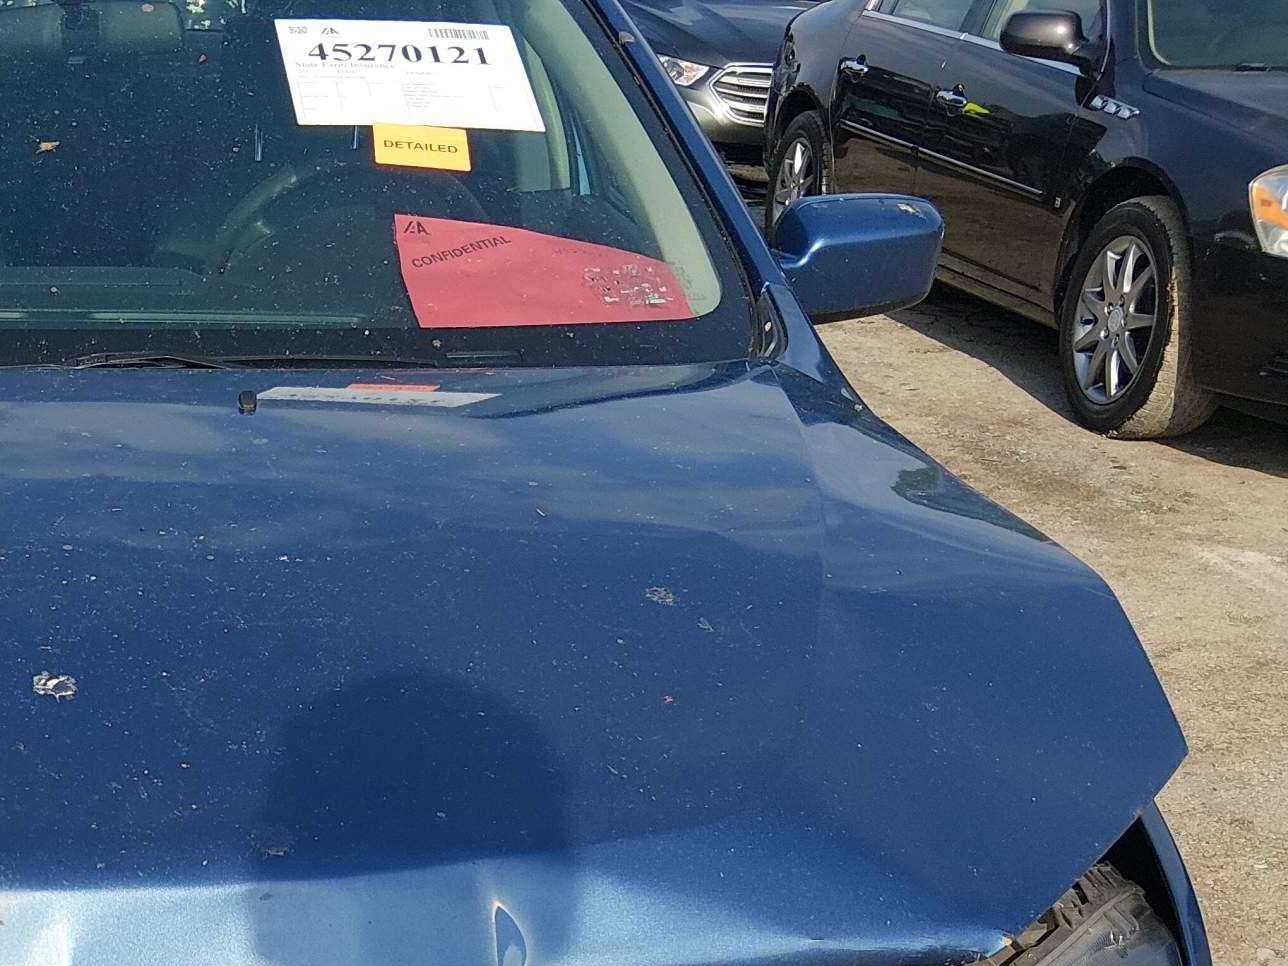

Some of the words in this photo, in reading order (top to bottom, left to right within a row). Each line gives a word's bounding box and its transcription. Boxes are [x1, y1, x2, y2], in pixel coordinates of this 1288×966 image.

[308, 43, 492, 65] 45270121
[383, 139, 458, 154] DETAILED
[411, 235, 512, 269] CONFIDENTIAL
